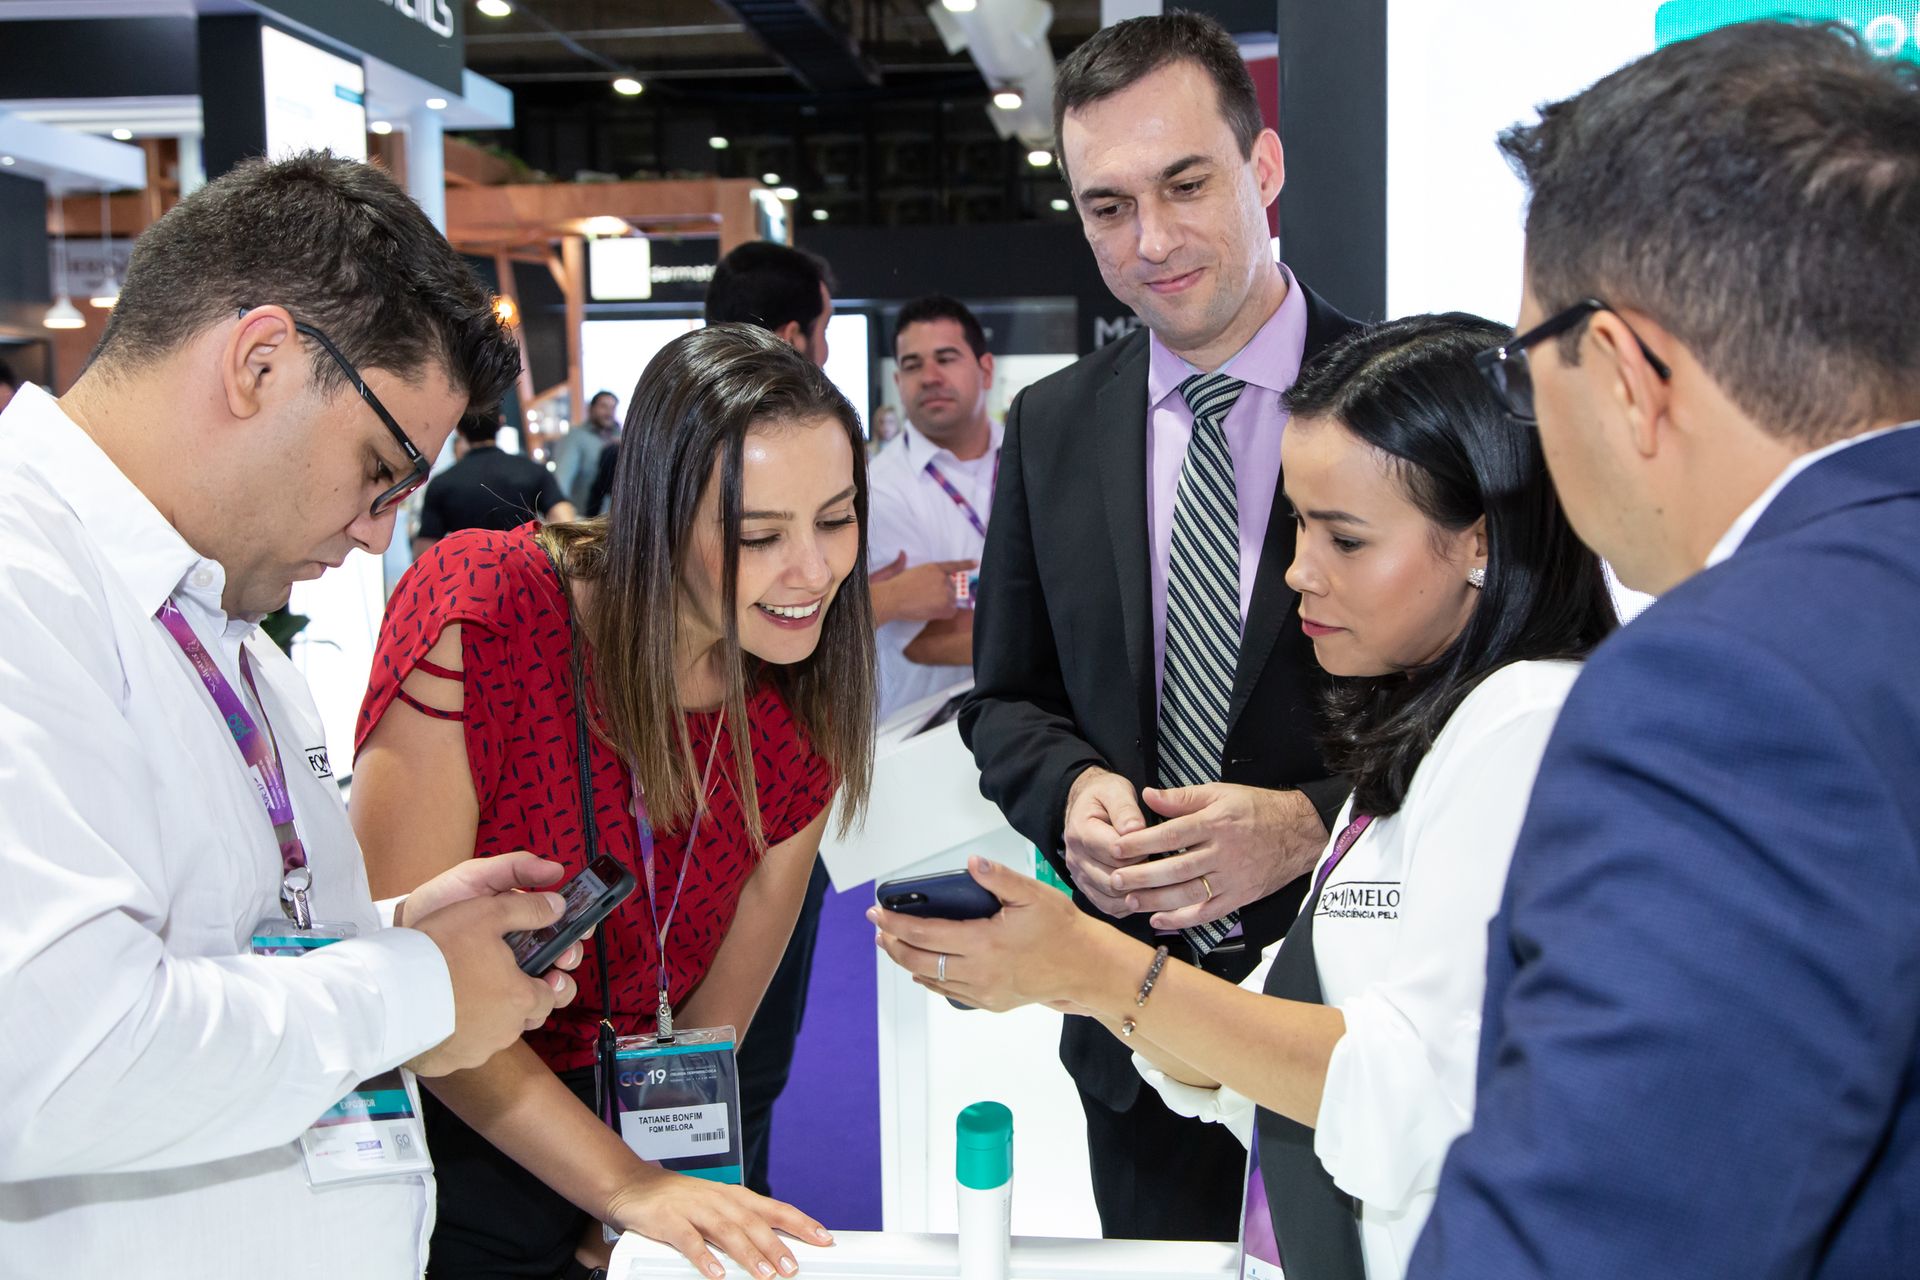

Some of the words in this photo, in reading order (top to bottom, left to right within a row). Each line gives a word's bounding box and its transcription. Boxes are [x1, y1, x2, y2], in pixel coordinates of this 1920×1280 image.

[639, 1115, 670, 1125] TATIANE
[673, 1112, 703, 1122] BONFIM
[665, 1123, 694, 1132] MELORA
